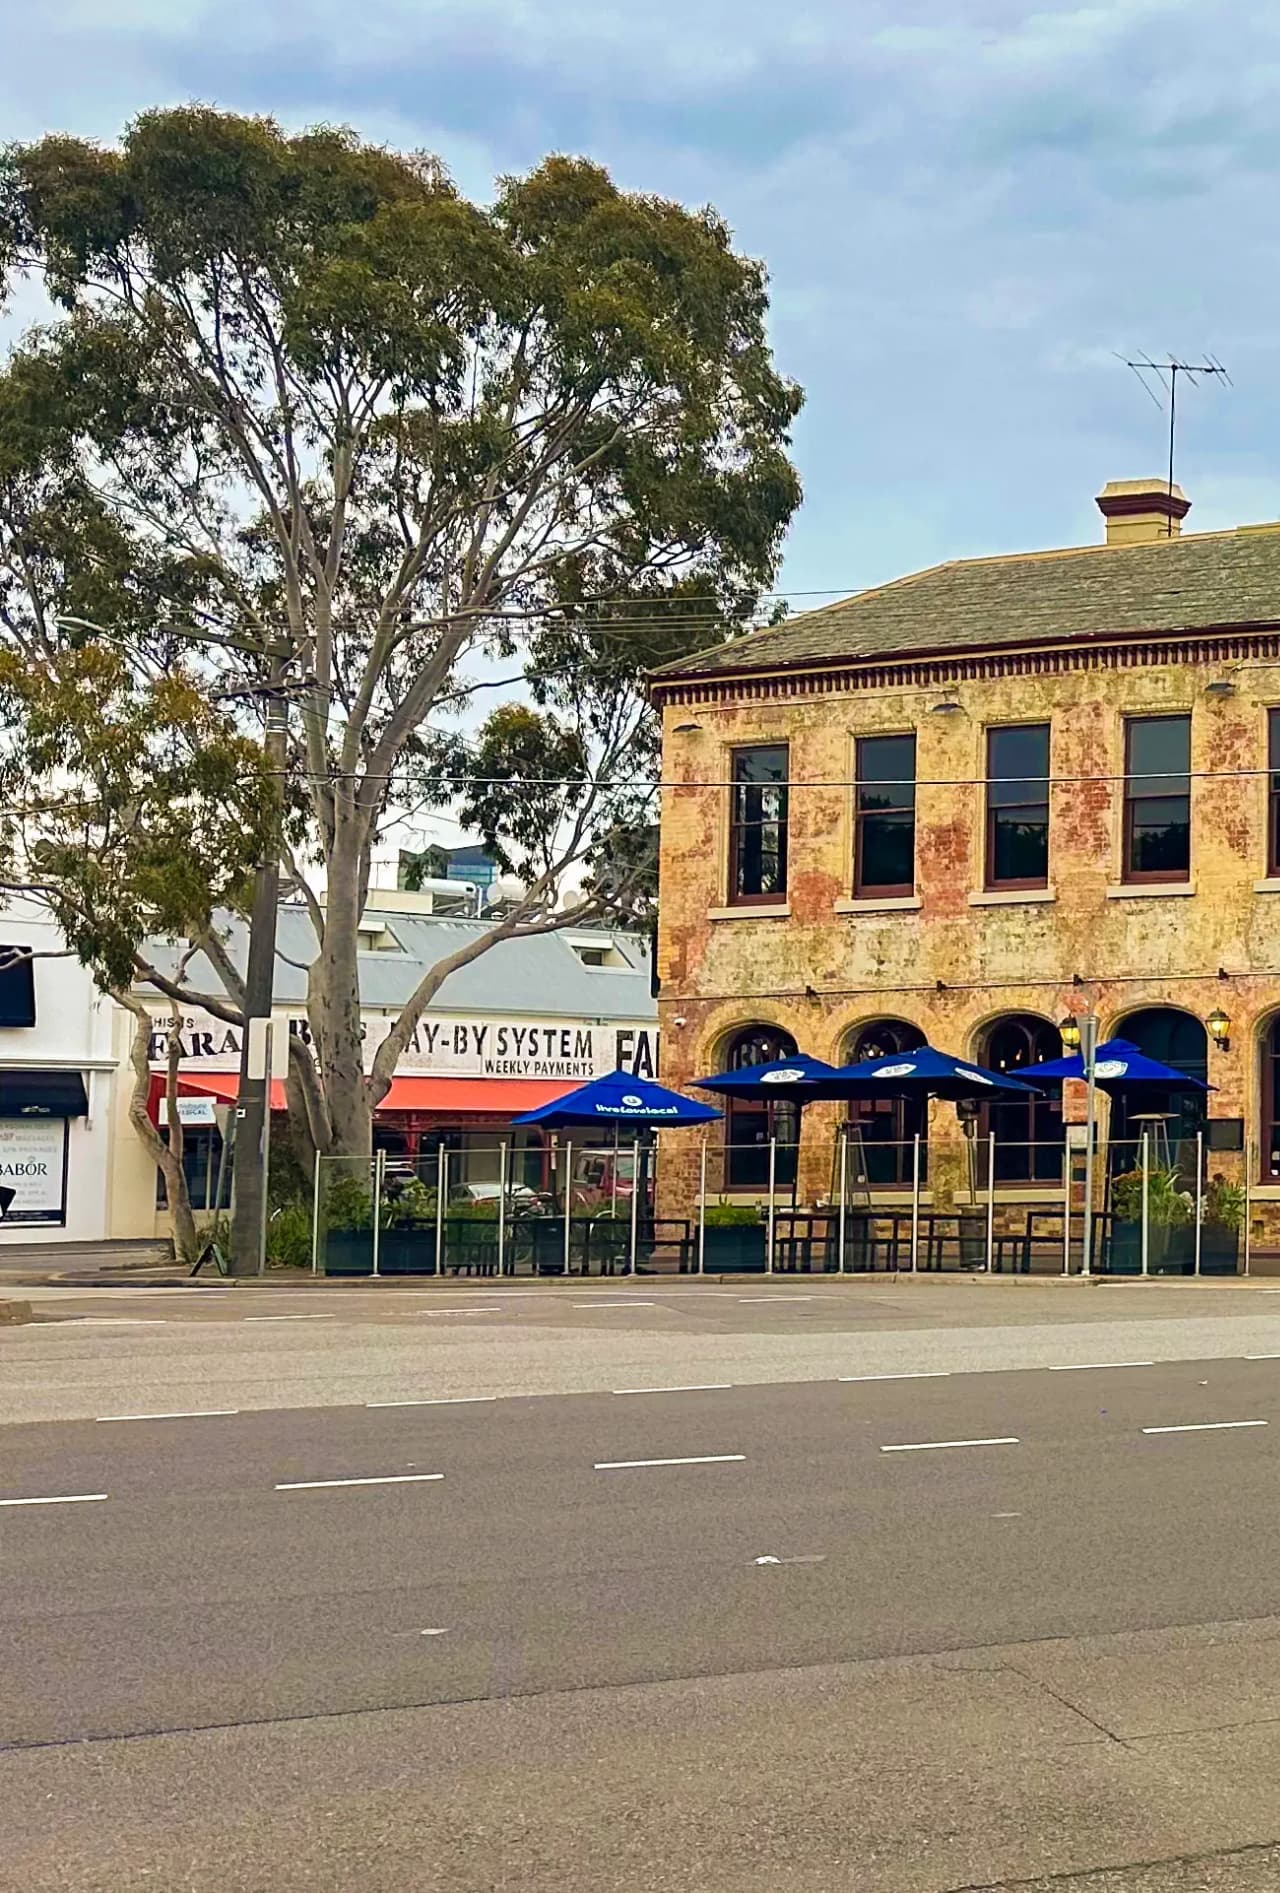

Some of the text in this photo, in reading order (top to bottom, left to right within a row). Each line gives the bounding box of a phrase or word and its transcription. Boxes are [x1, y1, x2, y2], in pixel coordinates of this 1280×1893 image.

[153, 1016, 176, 1028] HIS
[496, 1027, 593, 1058] SYSTEM
[616, 1030, 660, 1079] FA
[485, 1060, 594, 1076] WEEKLY PAYMENTS
